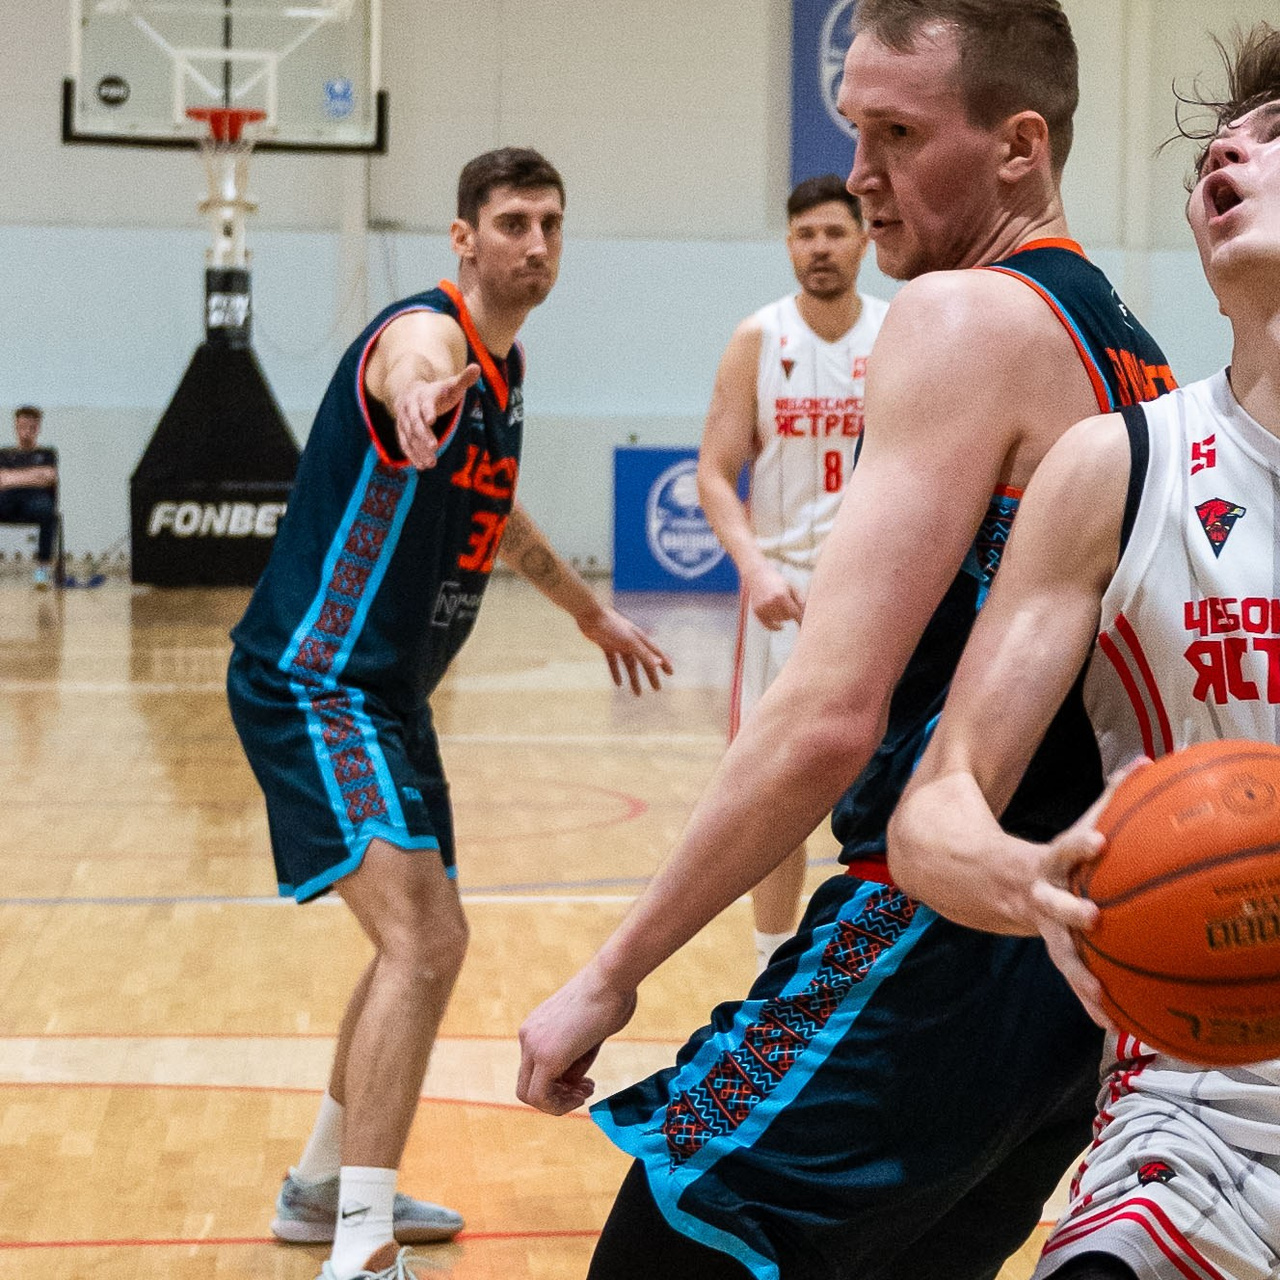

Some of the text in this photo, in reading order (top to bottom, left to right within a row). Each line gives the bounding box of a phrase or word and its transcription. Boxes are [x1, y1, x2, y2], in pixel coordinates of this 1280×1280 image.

[774, 413, 865, 438] ЯСТРЕ
[824, 450, 843, 493] 8
[148, 501, 288, 537] FONBE
